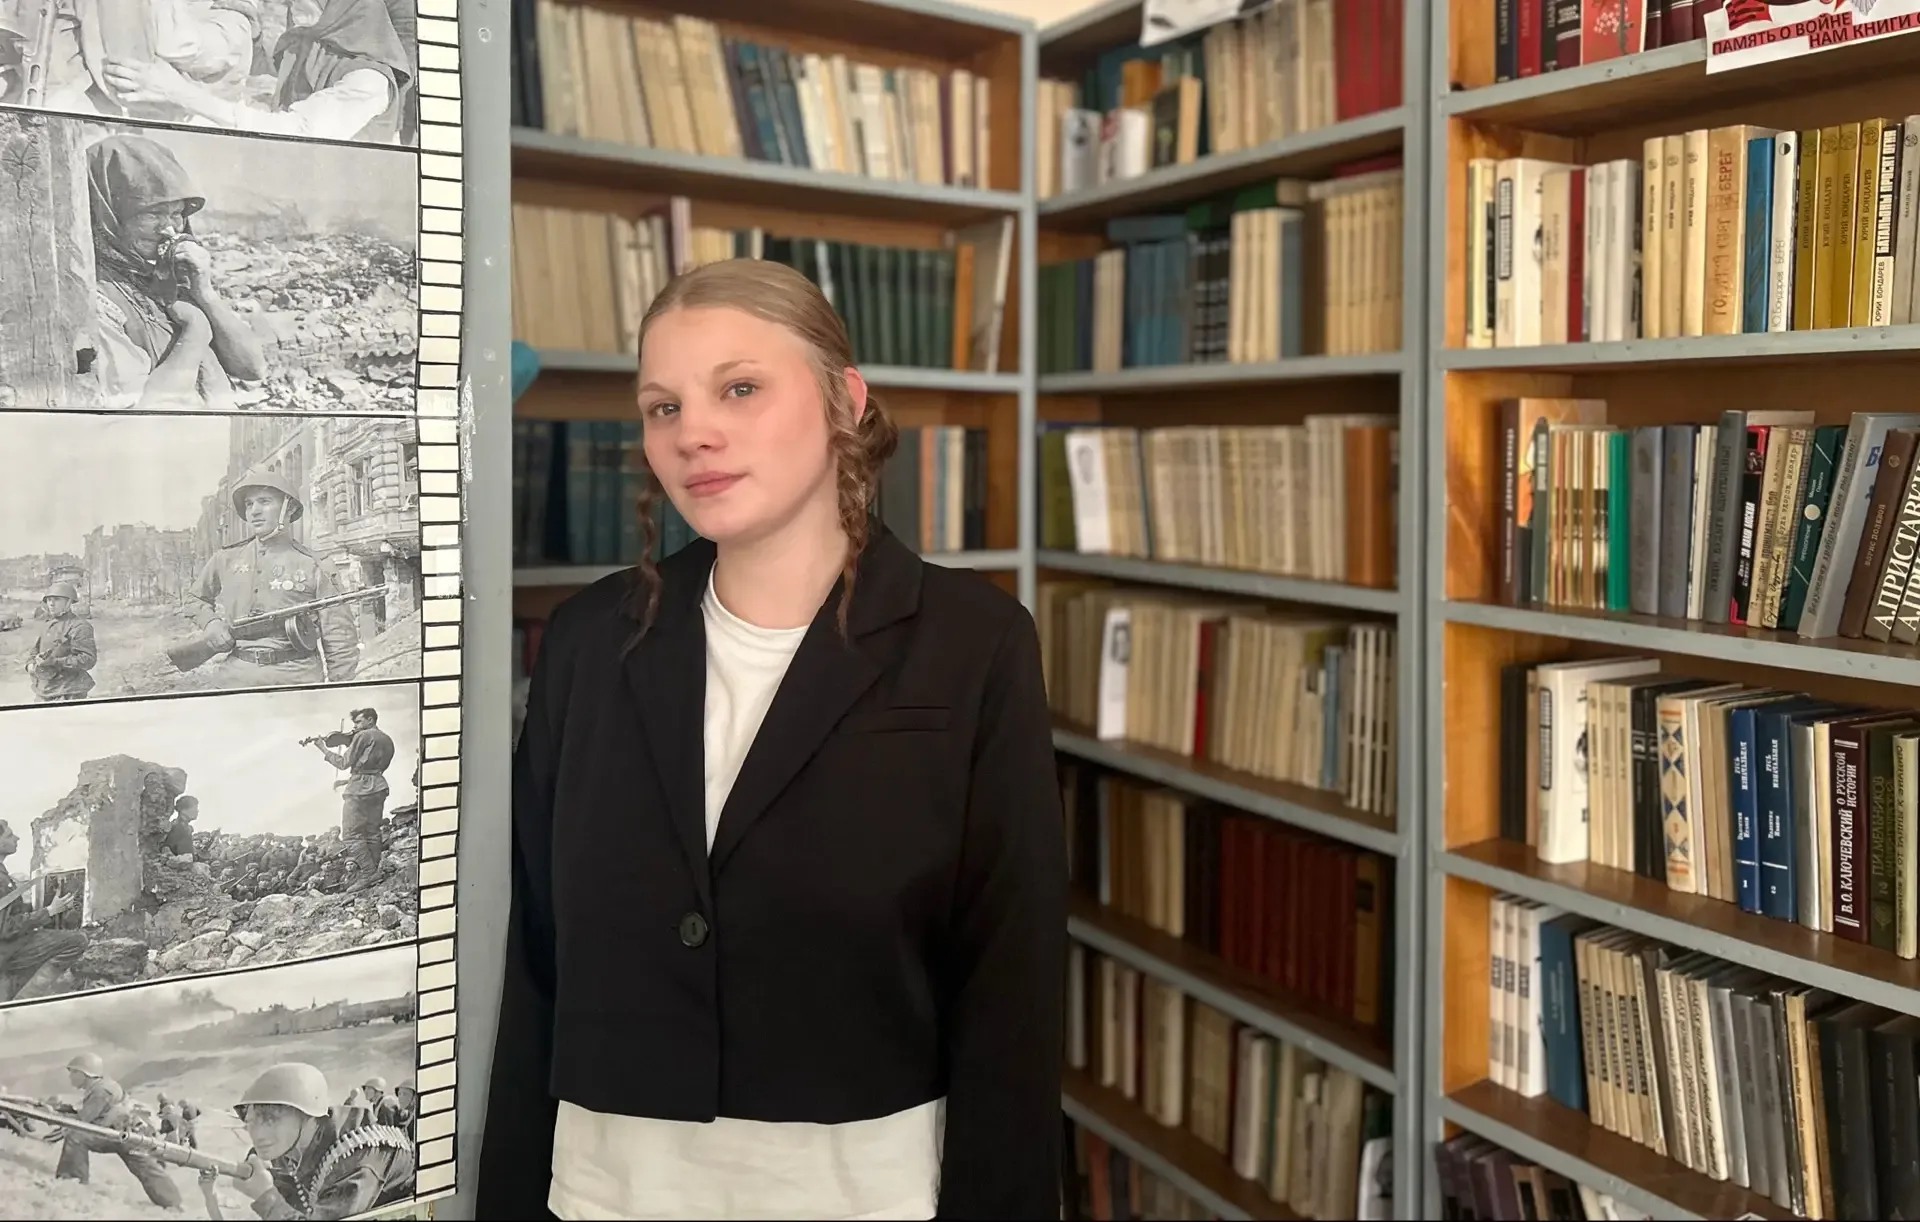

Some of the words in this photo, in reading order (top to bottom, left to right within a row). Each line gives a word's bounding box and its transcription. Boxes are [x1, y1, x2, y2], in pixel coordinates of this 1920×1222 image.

[1713, 33, 1776, 55] ПАМЯТЬ
[1780, 27, 1791, 40] О
[1796, 12, 1850, 36] ВОЙНЕ
[1810, 29, 1848, 48] НАМ
[1853, 16, 1911, 38] КНИГИ
[1883, 130, 1896, 154] ОГНЯ
[1718, 148, 1732, 192] БЕРЕГ
[1880, 156, 1895, 191] ПРОСЯТ
[1803, 180, 1812, 222] БОНДАРЕВ
[1823, 177, 1832, 220] БОНДАРЕВ
[1842, 174, 1851, 217] БОНДАРЕВ
[1862, 169, 1872, 213] БОНДАРЕВ
[1822, 223, 1830, 247] ЮРИЙ
[1860, 216, 1869, 241] ЮРИЙ
[1877, 194, 1892, 254] БАТАЛЬОНЫ
[1876, 262, 1885, 298] БОНДАРЕВ
[1874, 301, 1883, 322] ЮРИЙ
[1744, 501, 1756, 528] МОСКВА
[1741, 549, 1750, 558] ЗА
[1742, 529, 1753, 548] НАМИ
[1835, 752, 1846, 795] РУССКОЙ
[1847, 765, 1857, 807] ИСТОРИИ
[1837, 810, 1854, 890] КЛЮЧЕВСКИЙ
[1841, 892, 1852, 901] О.
[1841, 903, 1852, 913] В.
